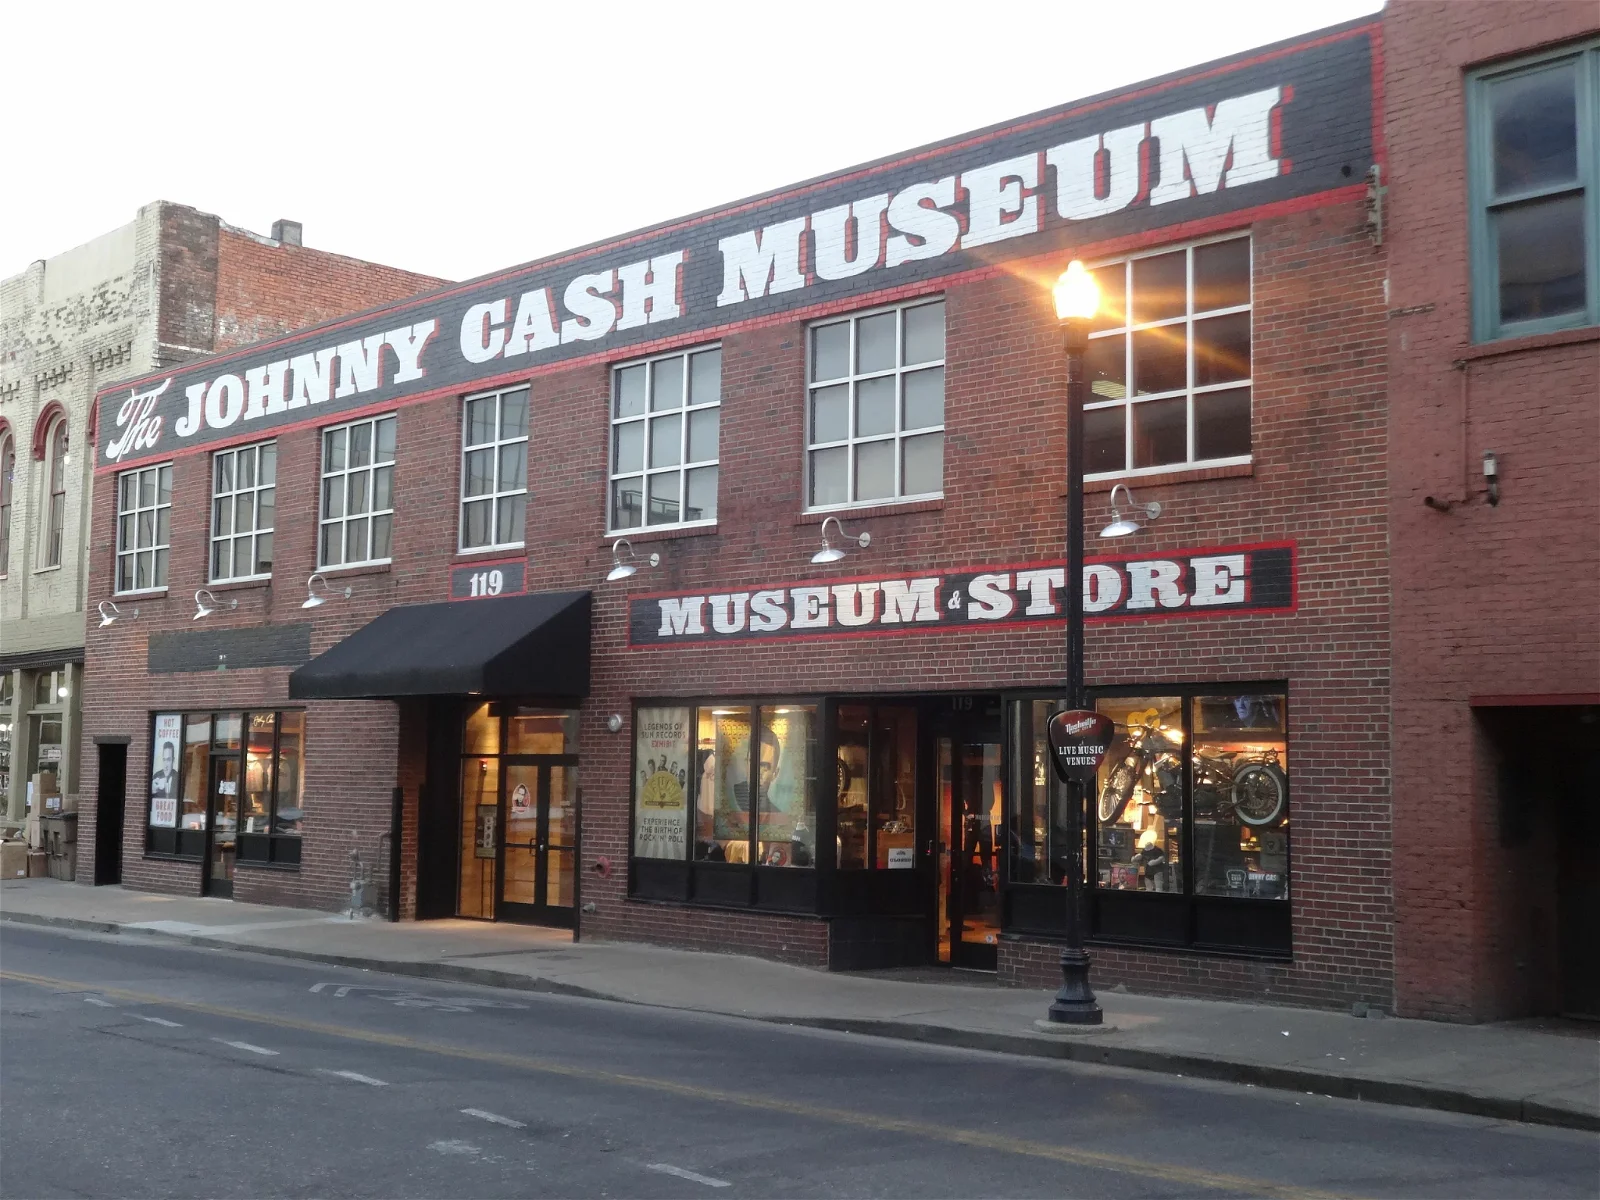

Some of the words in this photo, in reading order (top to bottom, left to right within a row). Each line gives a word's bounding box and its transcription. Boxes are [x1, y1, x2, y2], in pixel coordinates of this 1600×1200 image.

[105, 377, 171, 463] The
[174, 318, 437, 438] JOHNNY
[459, 249, 685, 364] CASH
[715, 84, 1282, 308] MUSEUM
[469, 569, 503, 598] 119
[657, 577, 940, 637] MUSEUM
[947, 590, 961, 610] &
[967, 553, 1246, 621] STORE
[952, 695, 973, 711] 119
[163, 718, 175, 728] HOT
[644, 722, 673, 731] LEGENDS
[674, 722, 684, 731] OF
[158, 728, 180, 739] COFFEE
[641, 731, 654, 739] SUN
[655, 731, 686, 739] RECORDS
[651, 740, 677, 748] EXHIBIT
[1058, 746, 1077, 755] LIVE
[1077, 745, 1104, 755] MUSIC
[1066, 756, 1097, 766] VENUES
[155, 800, 175, 811] GREAT
[156, 811, 173, 822] FOOD
[643, 817, 681, 827] EXPERIENCE
[641, 825, 653, 834] THE
[654, 826, 672, 835] BIRTH
[673, 827, 683, 835] OF
[640, 833, 656, 842] ROCK
[668, 835, 684, 844] ROLL
